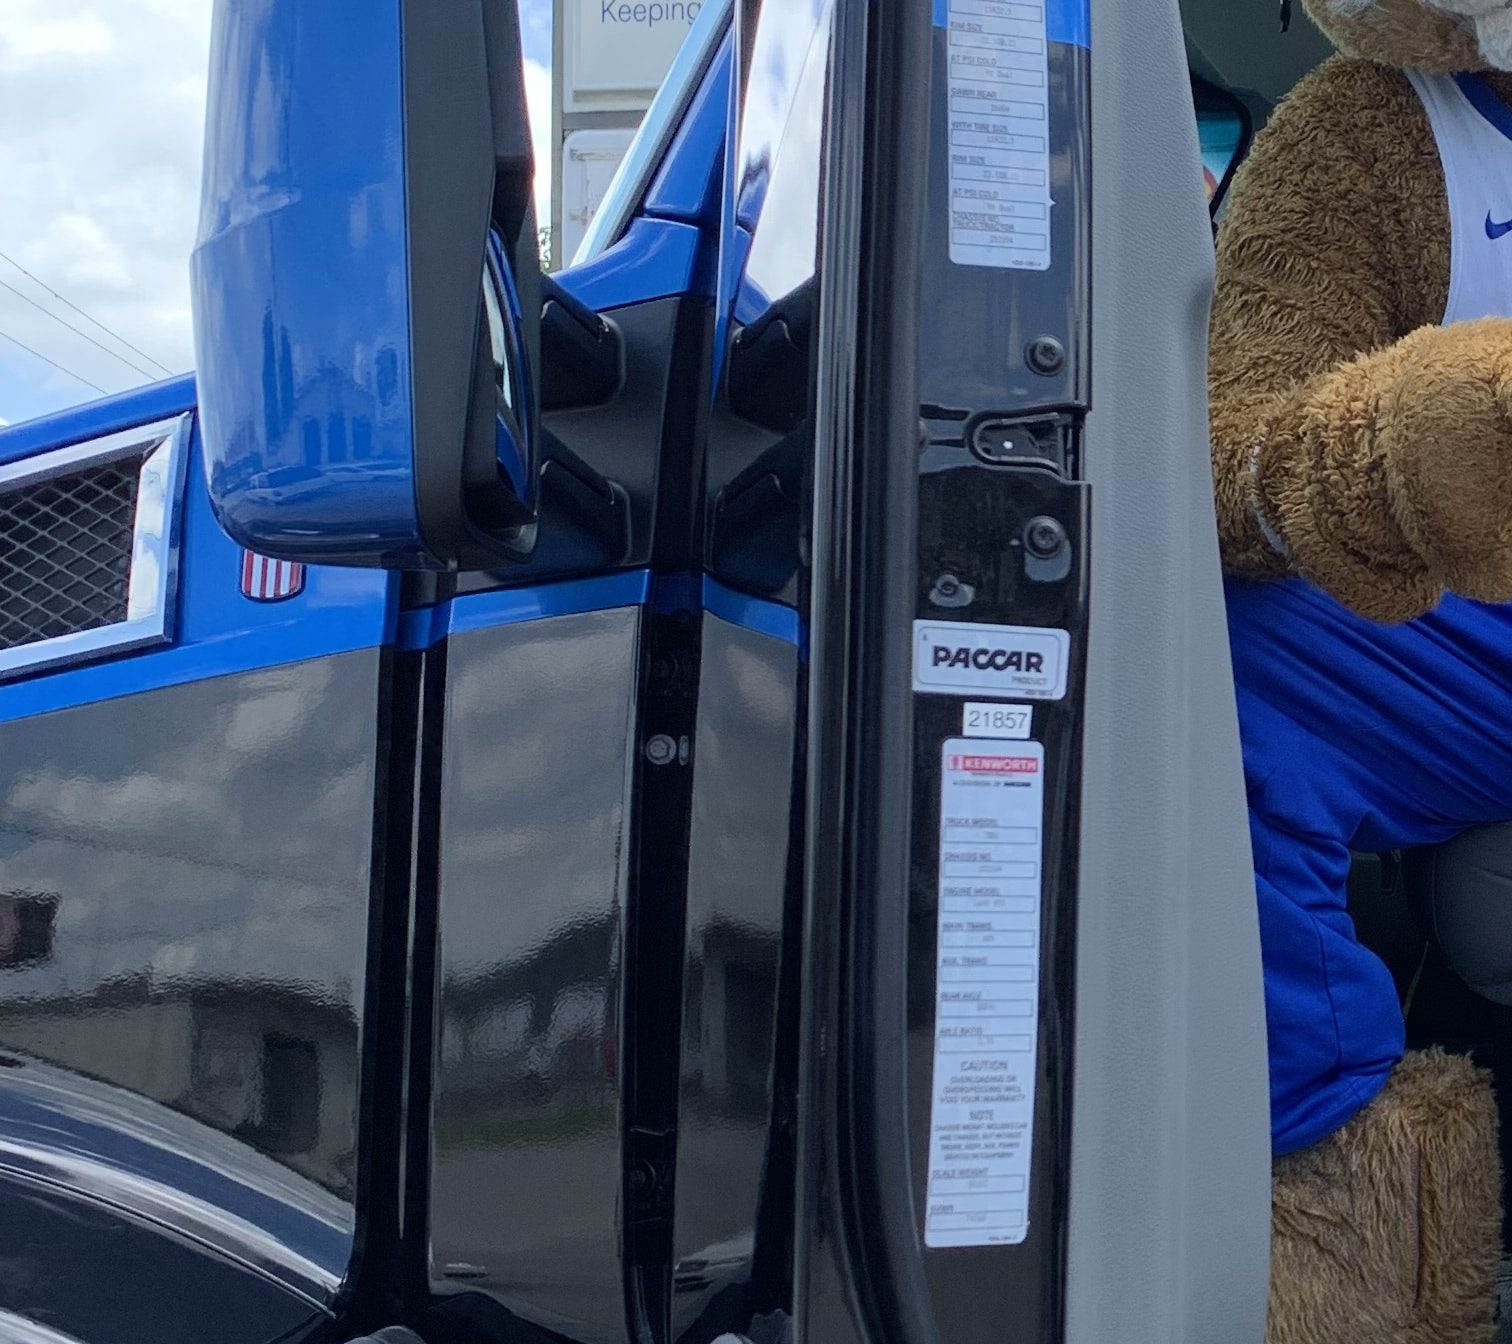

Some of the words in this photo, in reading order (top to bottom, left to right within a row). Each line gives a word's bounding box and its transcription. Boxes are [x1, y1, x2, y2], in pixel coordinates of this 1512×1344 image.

[932, 645, 1044, 673] PACCAR
[968, 710, 1027, 729] 21857
[965, 758, 1036, 771] KENWORTH
[961, 1060, 1008, 1071] CAUTION
[969, 1110, 993, 1120] NOTE
